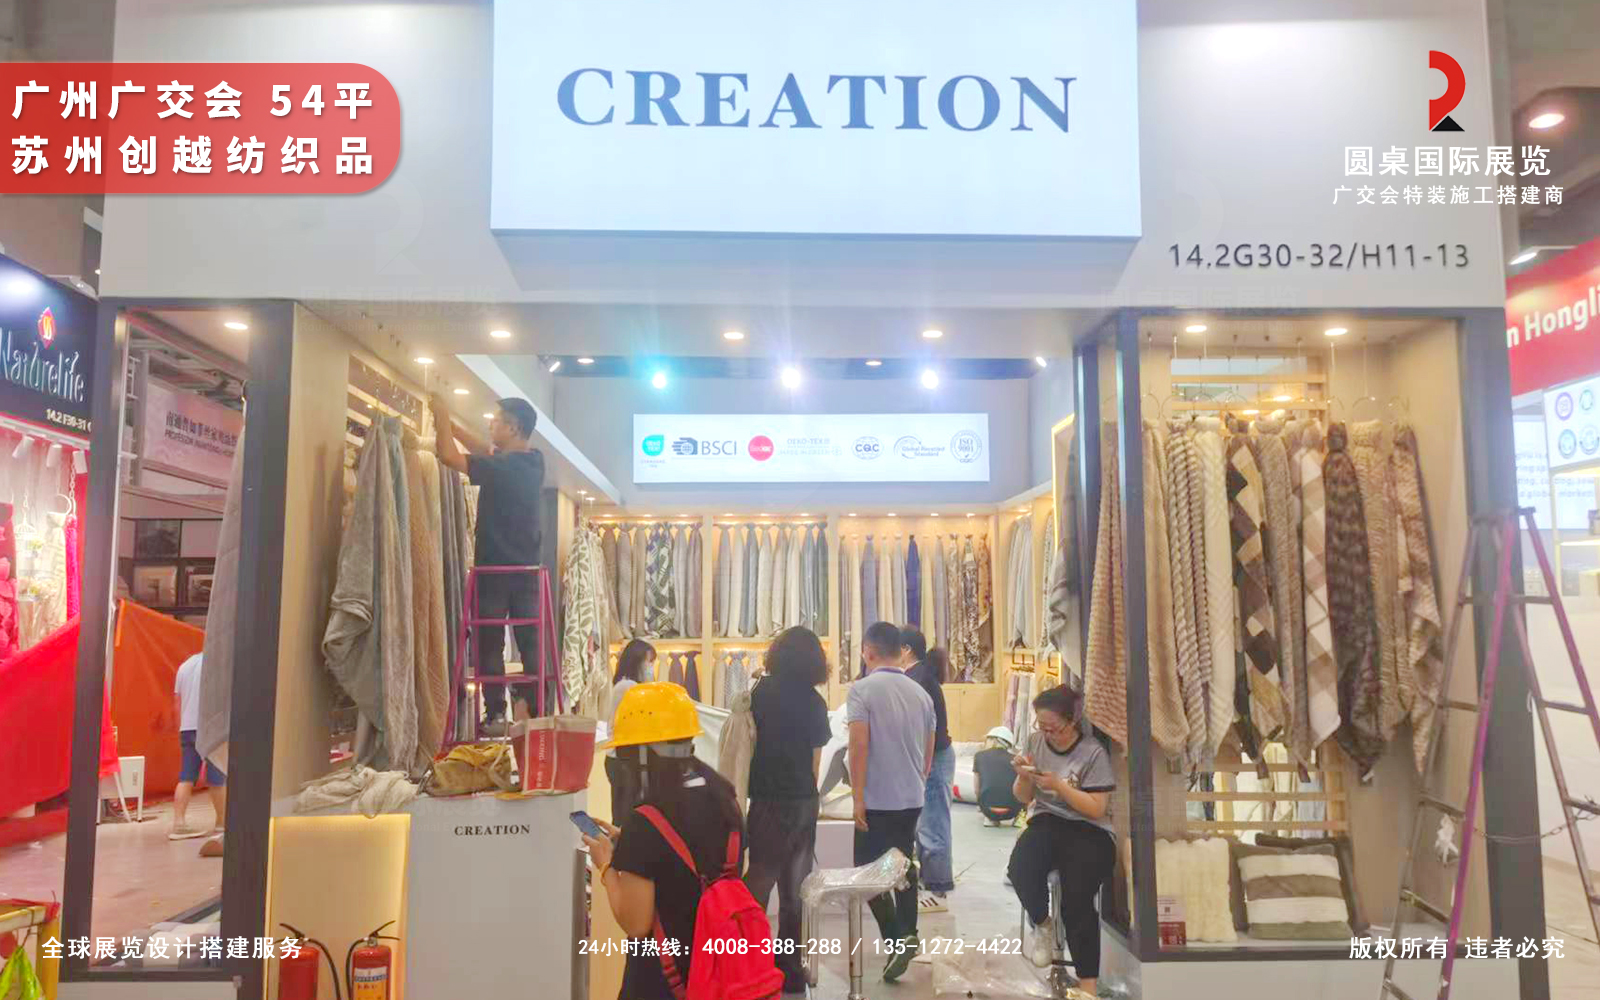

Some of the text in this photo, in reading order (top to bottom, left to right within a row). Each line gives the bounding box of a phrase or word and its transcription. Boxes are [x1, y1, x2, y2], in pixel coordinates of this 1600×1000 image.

[556, 67, 1078, 133] CREATION
[1169, 243, 1470, 271] 14.2G30-32/H11-13
[701, 440, 737, 456] BSCI
[454, 824, 531, 836] CREATION
